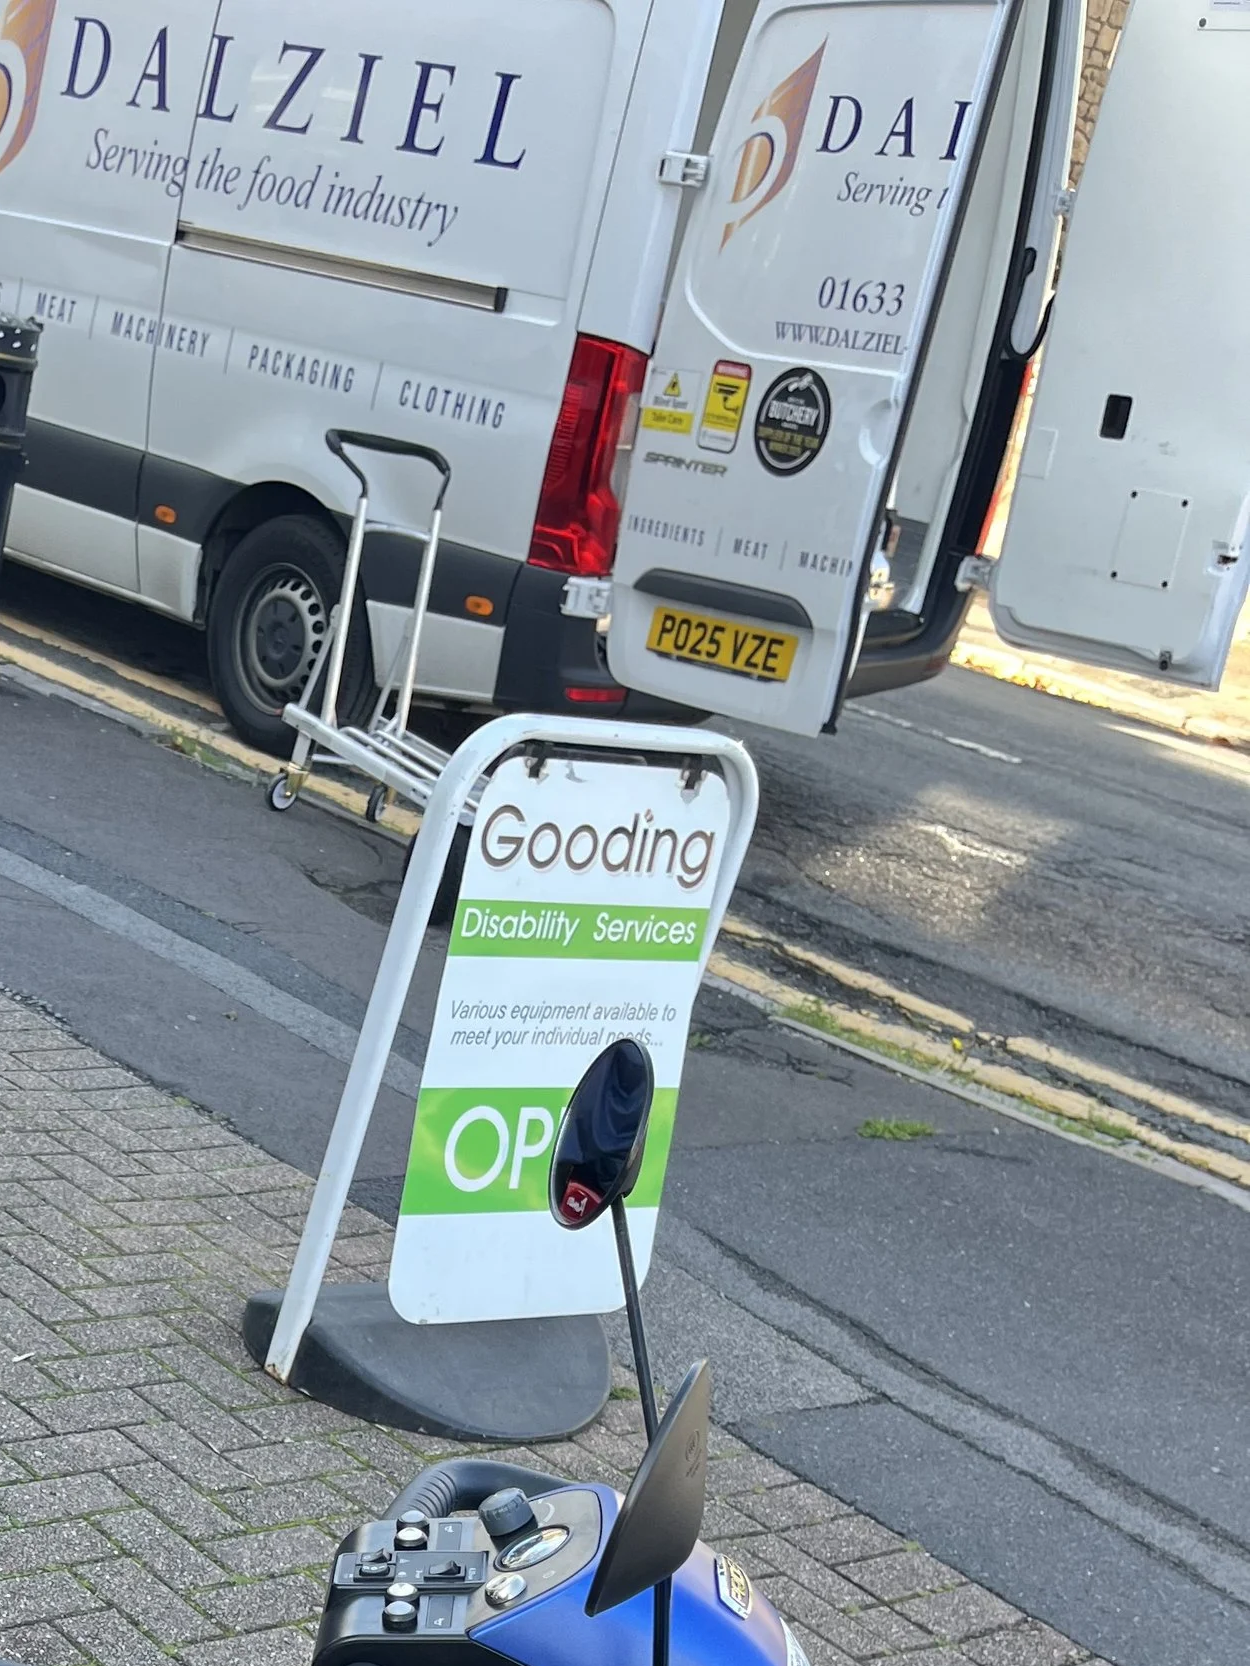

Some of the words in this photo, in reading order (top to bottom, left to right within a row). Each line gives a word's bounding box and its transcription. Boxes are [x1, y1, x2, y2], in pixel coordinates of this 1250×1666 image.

[60, 16, 528, 170] DALZIEL
[86, 127, 189, 198] Serving
[196, 145, 239, 195] the
[238, 156, 322, 211] food
[323, 171, 459, 247] industry
[837, 171, 932, 217] Serving
[818, 276, 906, 317] 01633
[36, 292, 77, 324] MEAT
[110, 311, 212, 357] MACHINERY
[248, 344, 355, 393] PACKAGING
[399, 380, 506, 430] CLOTHING
[643, 451, 728, 477] SPRINTER
[627, 514, 705, 547] INGREDIENTS
[733, 538, 768, 560] MEAT
[656, 613, 726, 660] PO25
[730, 630, 785, 674] VZE
[481, 803, 716, 889] Gooding
[461, 907, 579, 946] Disability
[593, 911, 697, 945] Services
[450, 1000, 506, 1020] Various
[510, 1001, 592, 1024] equipment
[593, 1002, 658, 1021] available
[662, 1004, 677, 1022] to
[450, 1028, 492, 1046] meet
[492, 1030, 527, 1050] your
[531, 1027, 606, 1046] individual
